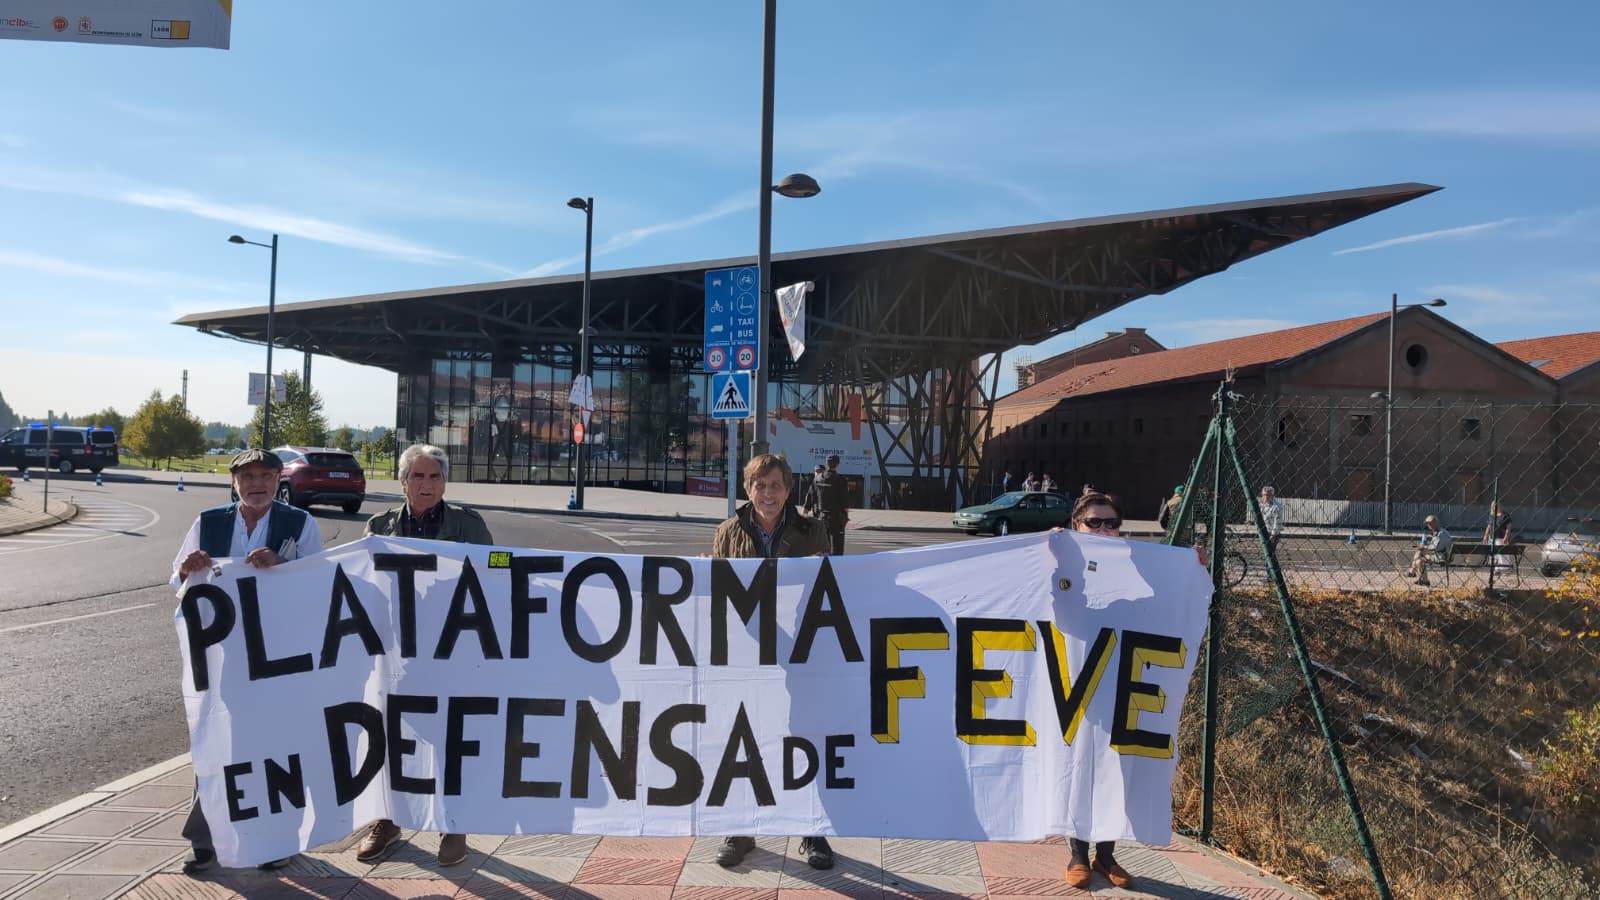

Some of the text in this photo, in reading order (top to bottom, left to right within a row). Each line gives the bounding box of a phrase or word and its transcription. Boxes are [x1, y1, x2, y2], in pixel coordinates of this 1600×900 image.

[738, 318, 754, 326] TAXI
[738, 330, 753, 338] BUS
[741, 353, 752, 361] 20
[181, 552, 865, 692] PLATAFORMA
[869, 617, 1187, 760] FEVE
[224, 694, 855, 822] EN DEFENSA DE
